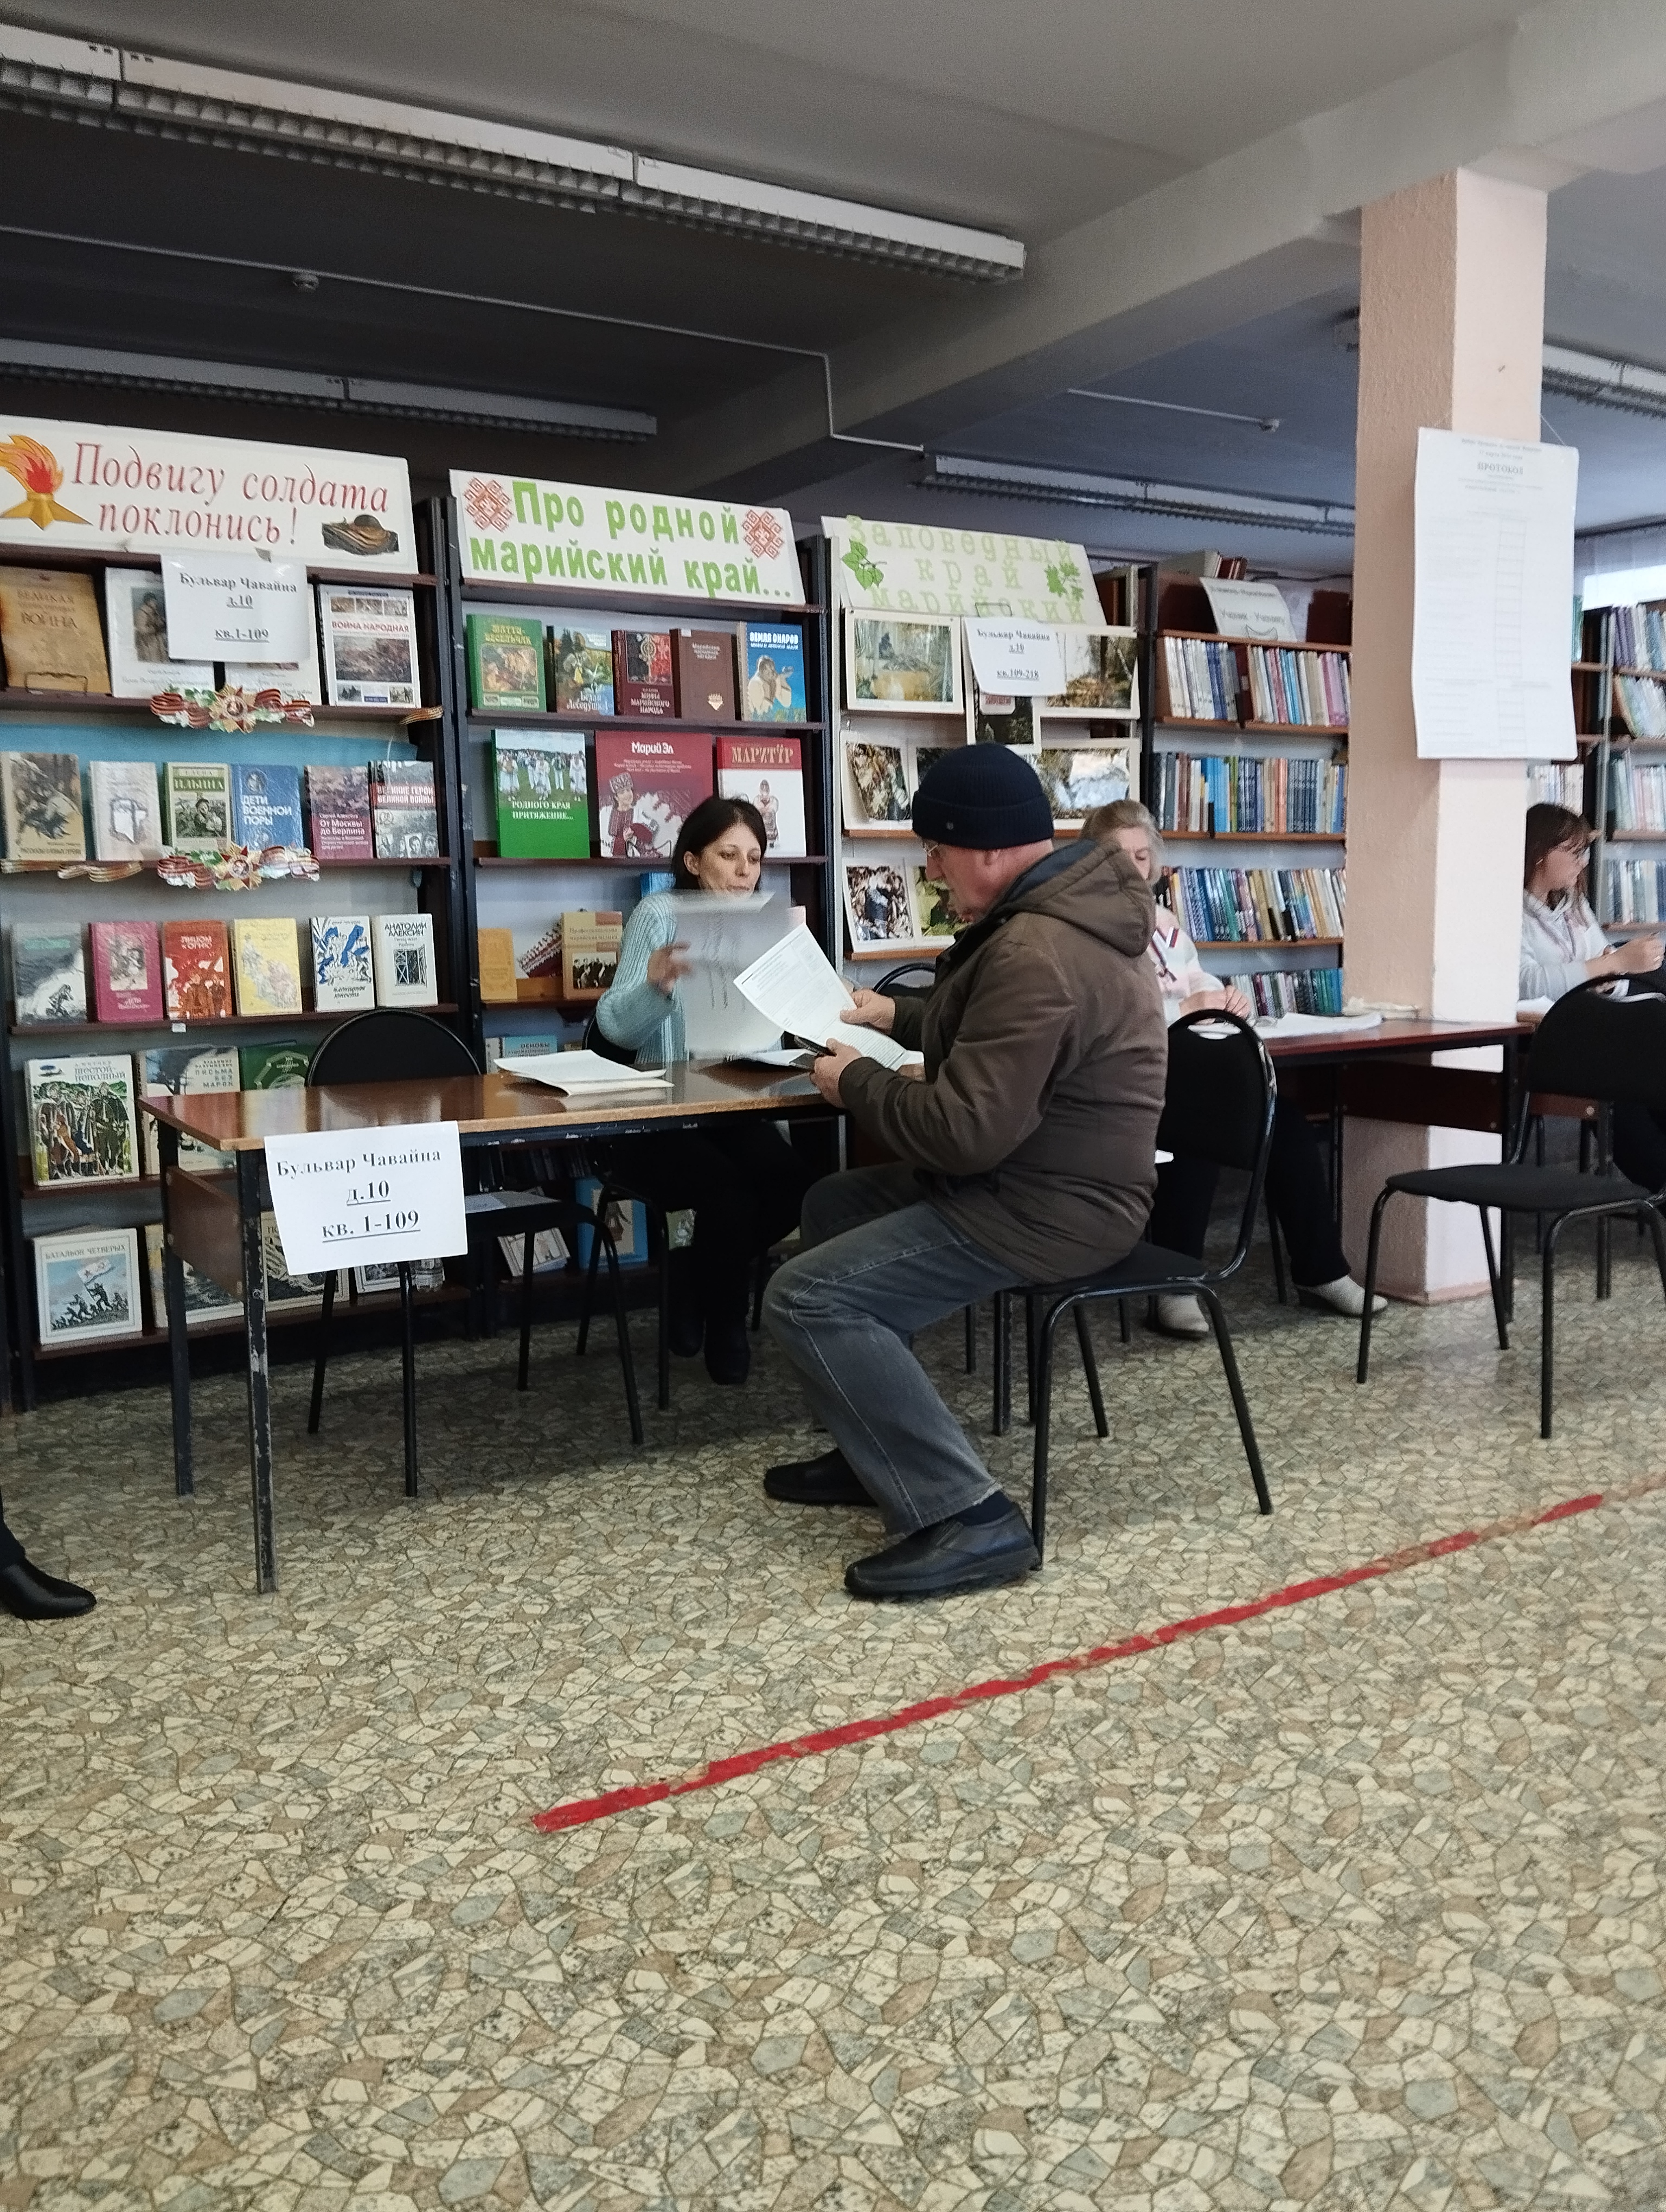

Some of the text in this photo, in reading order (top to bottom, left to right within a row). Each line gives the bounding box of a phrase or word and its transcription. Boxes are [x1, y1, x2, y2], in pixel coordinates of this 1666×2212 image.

[71, 441, 389, 513] Подвигу солдата
[1477, 461, 1524, 475] ПРОТОКОЛ
[512, 481, 740, 545] Про родной
[98, 503, 298, 544] поклонись!
[845, 515, 1073, 563] Заповедный
[469, 537, 791, 599] марийский край...
[915, 558, 1023, 590] край
[180, 573, 297, 593] Бульвар Чавайна
[332, 621, 409, 633] ВОЙНА НАРОДНАЯ
[631, 741, 674, 755] Марий Эл
[241, 795, 268, 806] ДЕТИ
[243, 805, 292, 816] ВОЕННОЙ
[512, 801, 571, 810] РОДНОГО КРАЯ
[244, 815, 273, 827] ПОРЫ
[319, 819, 363, 828] От Москвы
[321, 827, 365, 837] до Берлина
[277, 1149, 441, 1180] Бульвар Чавайна
[347, 1179, 391, 1205] д.10
[322, 1209, 420, 1239] кв. 1-109
